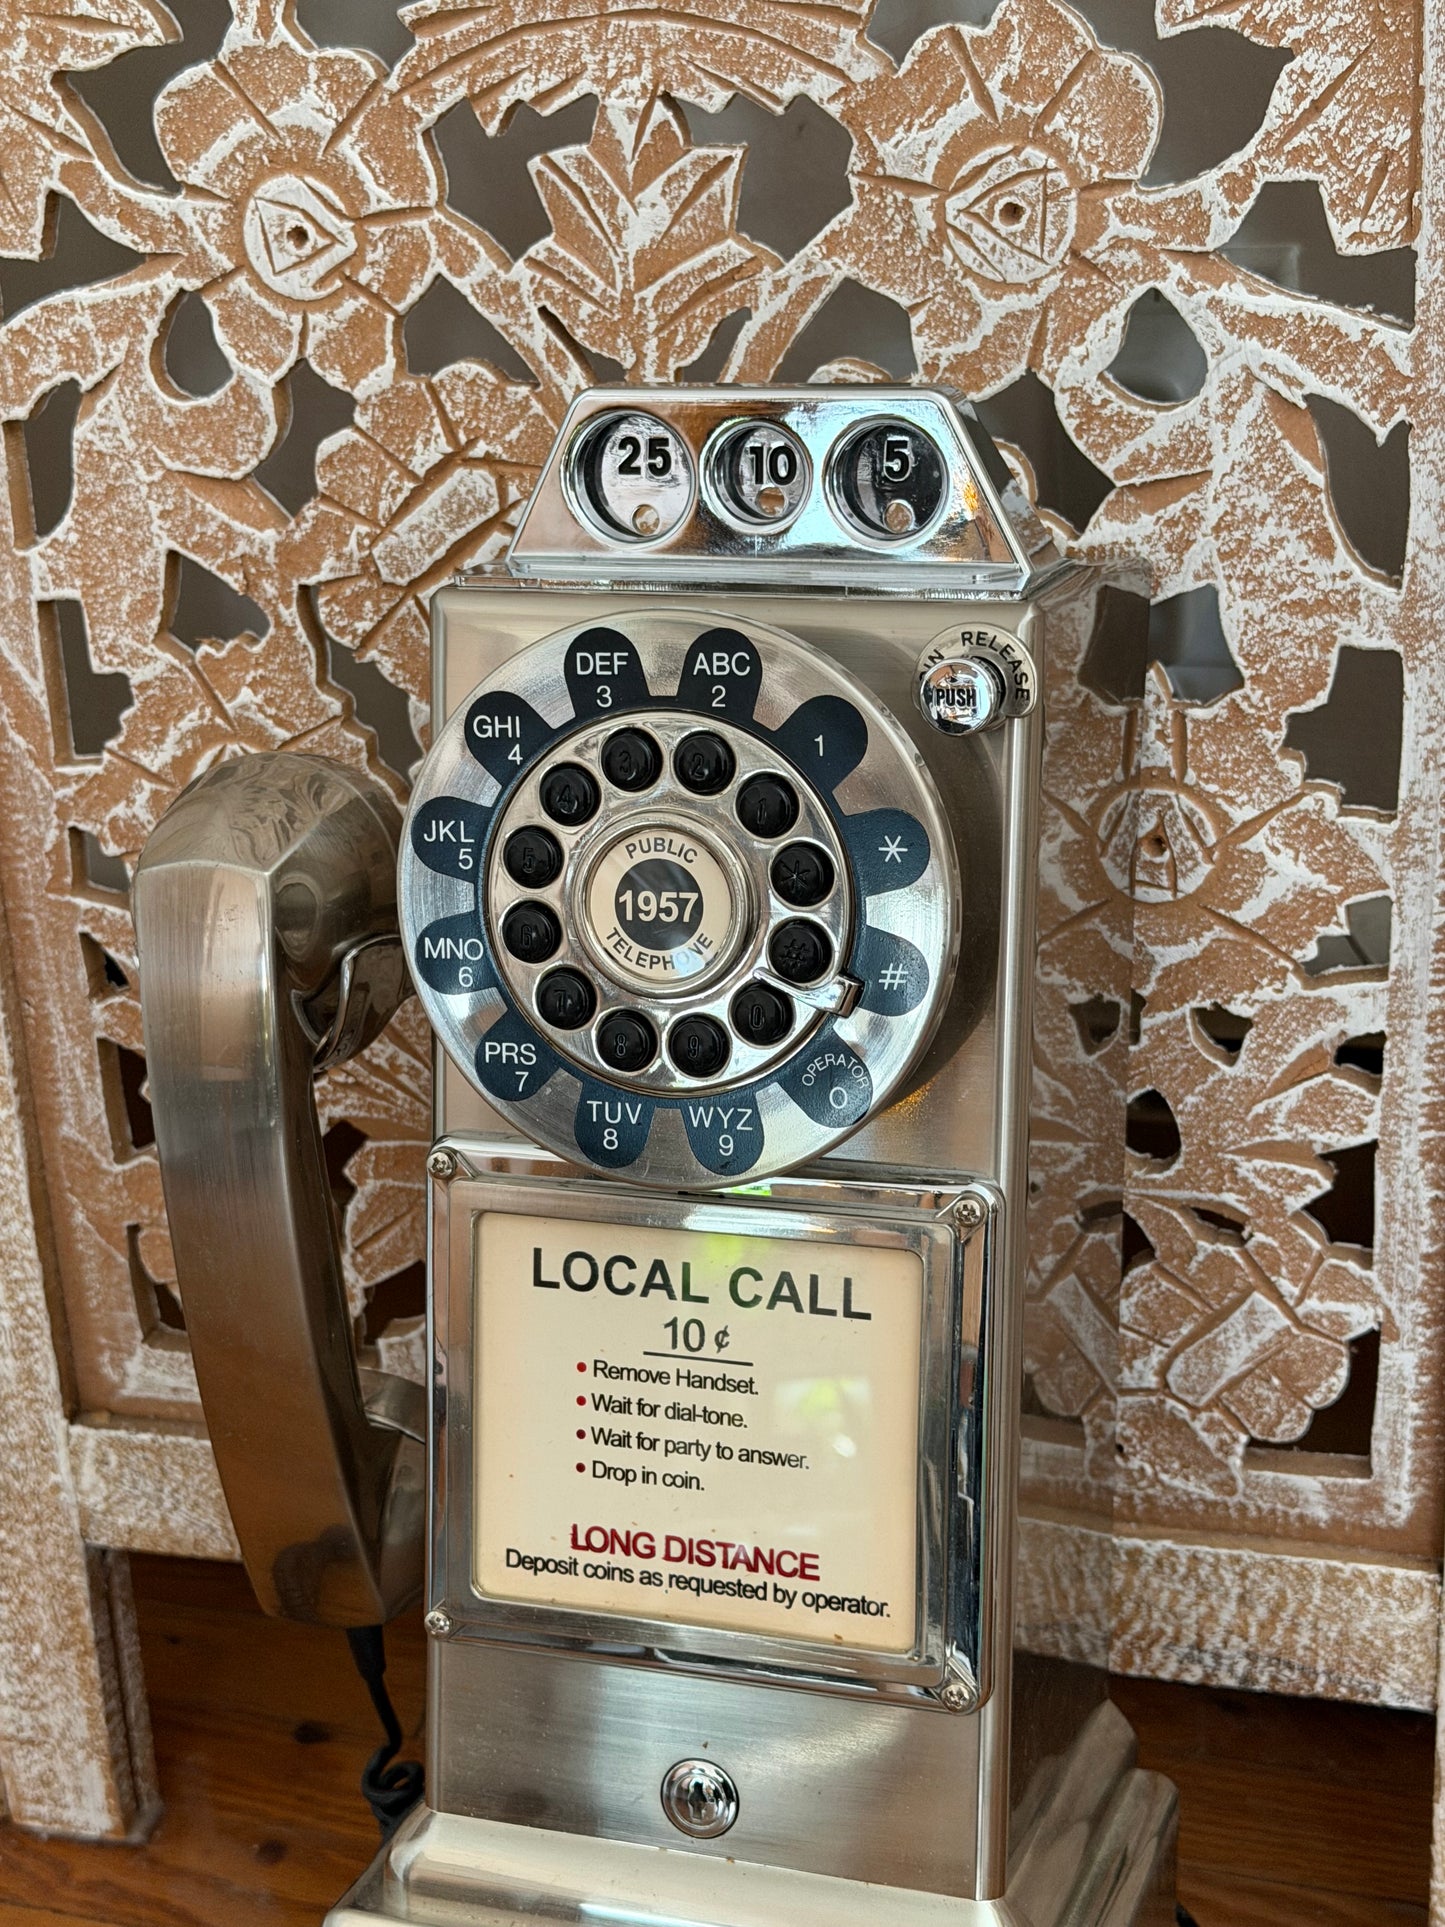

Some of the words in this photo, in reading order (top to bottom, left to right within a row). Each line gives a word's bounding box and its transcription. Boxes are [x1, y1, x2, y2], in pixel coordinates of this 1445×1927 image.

[618, 436, 672, 478] 25
[750, 445, 797, 486] 10
[884, 439, 911, 482] 5
[576, 652, 629, 676] DEF
[693, 652, 750, 676] ABC
[961, 630, 1031, 701] RELEASE
[596, 685, 613, 708] 3
[711, 685, 726, 708] 2
[936, 688, 977, 708] PUSH
[473, 715, 521, 739] GHI
[508, 743, 523, 766] 4
[813, 734, 824, 757] 1
[423, 820, 475, 843] JKL
[458, 848, 474, 870] 5
[625, 837, 698, 864] PUBLIC
[618, 889, 699, 923] 1957
[424, 937, 484, 961] MNO
[458, 966, 474, 988] 6
[485, 1042, 537, 1065] PRS
[615, 1033, 629, 1060] 8
[515, 1071, 529, 1092] 7
[801, 1053, 870, 1089] OPERATOR
[586, 1100, 642, 1125] TUV
[689, 1105, 753, 1131] WYZ
[603, 1128, 618, 1150] 8
[718, 1134, 734, 1157] 9
[533, 1247, 710, 1304] LOCAL
[728, 1266, 872, 1321] CALL
[664, 1316, 706, 1353] 10
[714, 1325, 730, 1354] ¢
[593, 1359, 671, 1386] Remove
[676, 1367, 759, 1396] Handset.
[590, 1392, 633, 1416] Wait
[636, 1398, 661, 1418] for
[664, 1401, 748, 1428] dial-tone.
[590, 1426, 633, 1449] Wait
[635, 1431, 661, 1452] for
[664, 1439, 712, 1462] party
[715, 1441, 734, 1461] to
[738, 1448, 810, 1470] answer.
[592, 1459, 637, 1487] Drop
[641, 1465, 657, 1486] in
[662, 1470, 705, 1491] coin.
[569, 1523, 656, 1559] LONG
[662, 1534, 821, 1582] DISTANCE
[506, 1547, 579, 1576] Deposit
[583, 1561, 634, 1584] coins
[639, 1570, 664, 1587] as
[668, 1573, 768, 1601] requested
[773, 1582, 798, 1609] by
[802, 1594, 891, 1618] operator.
